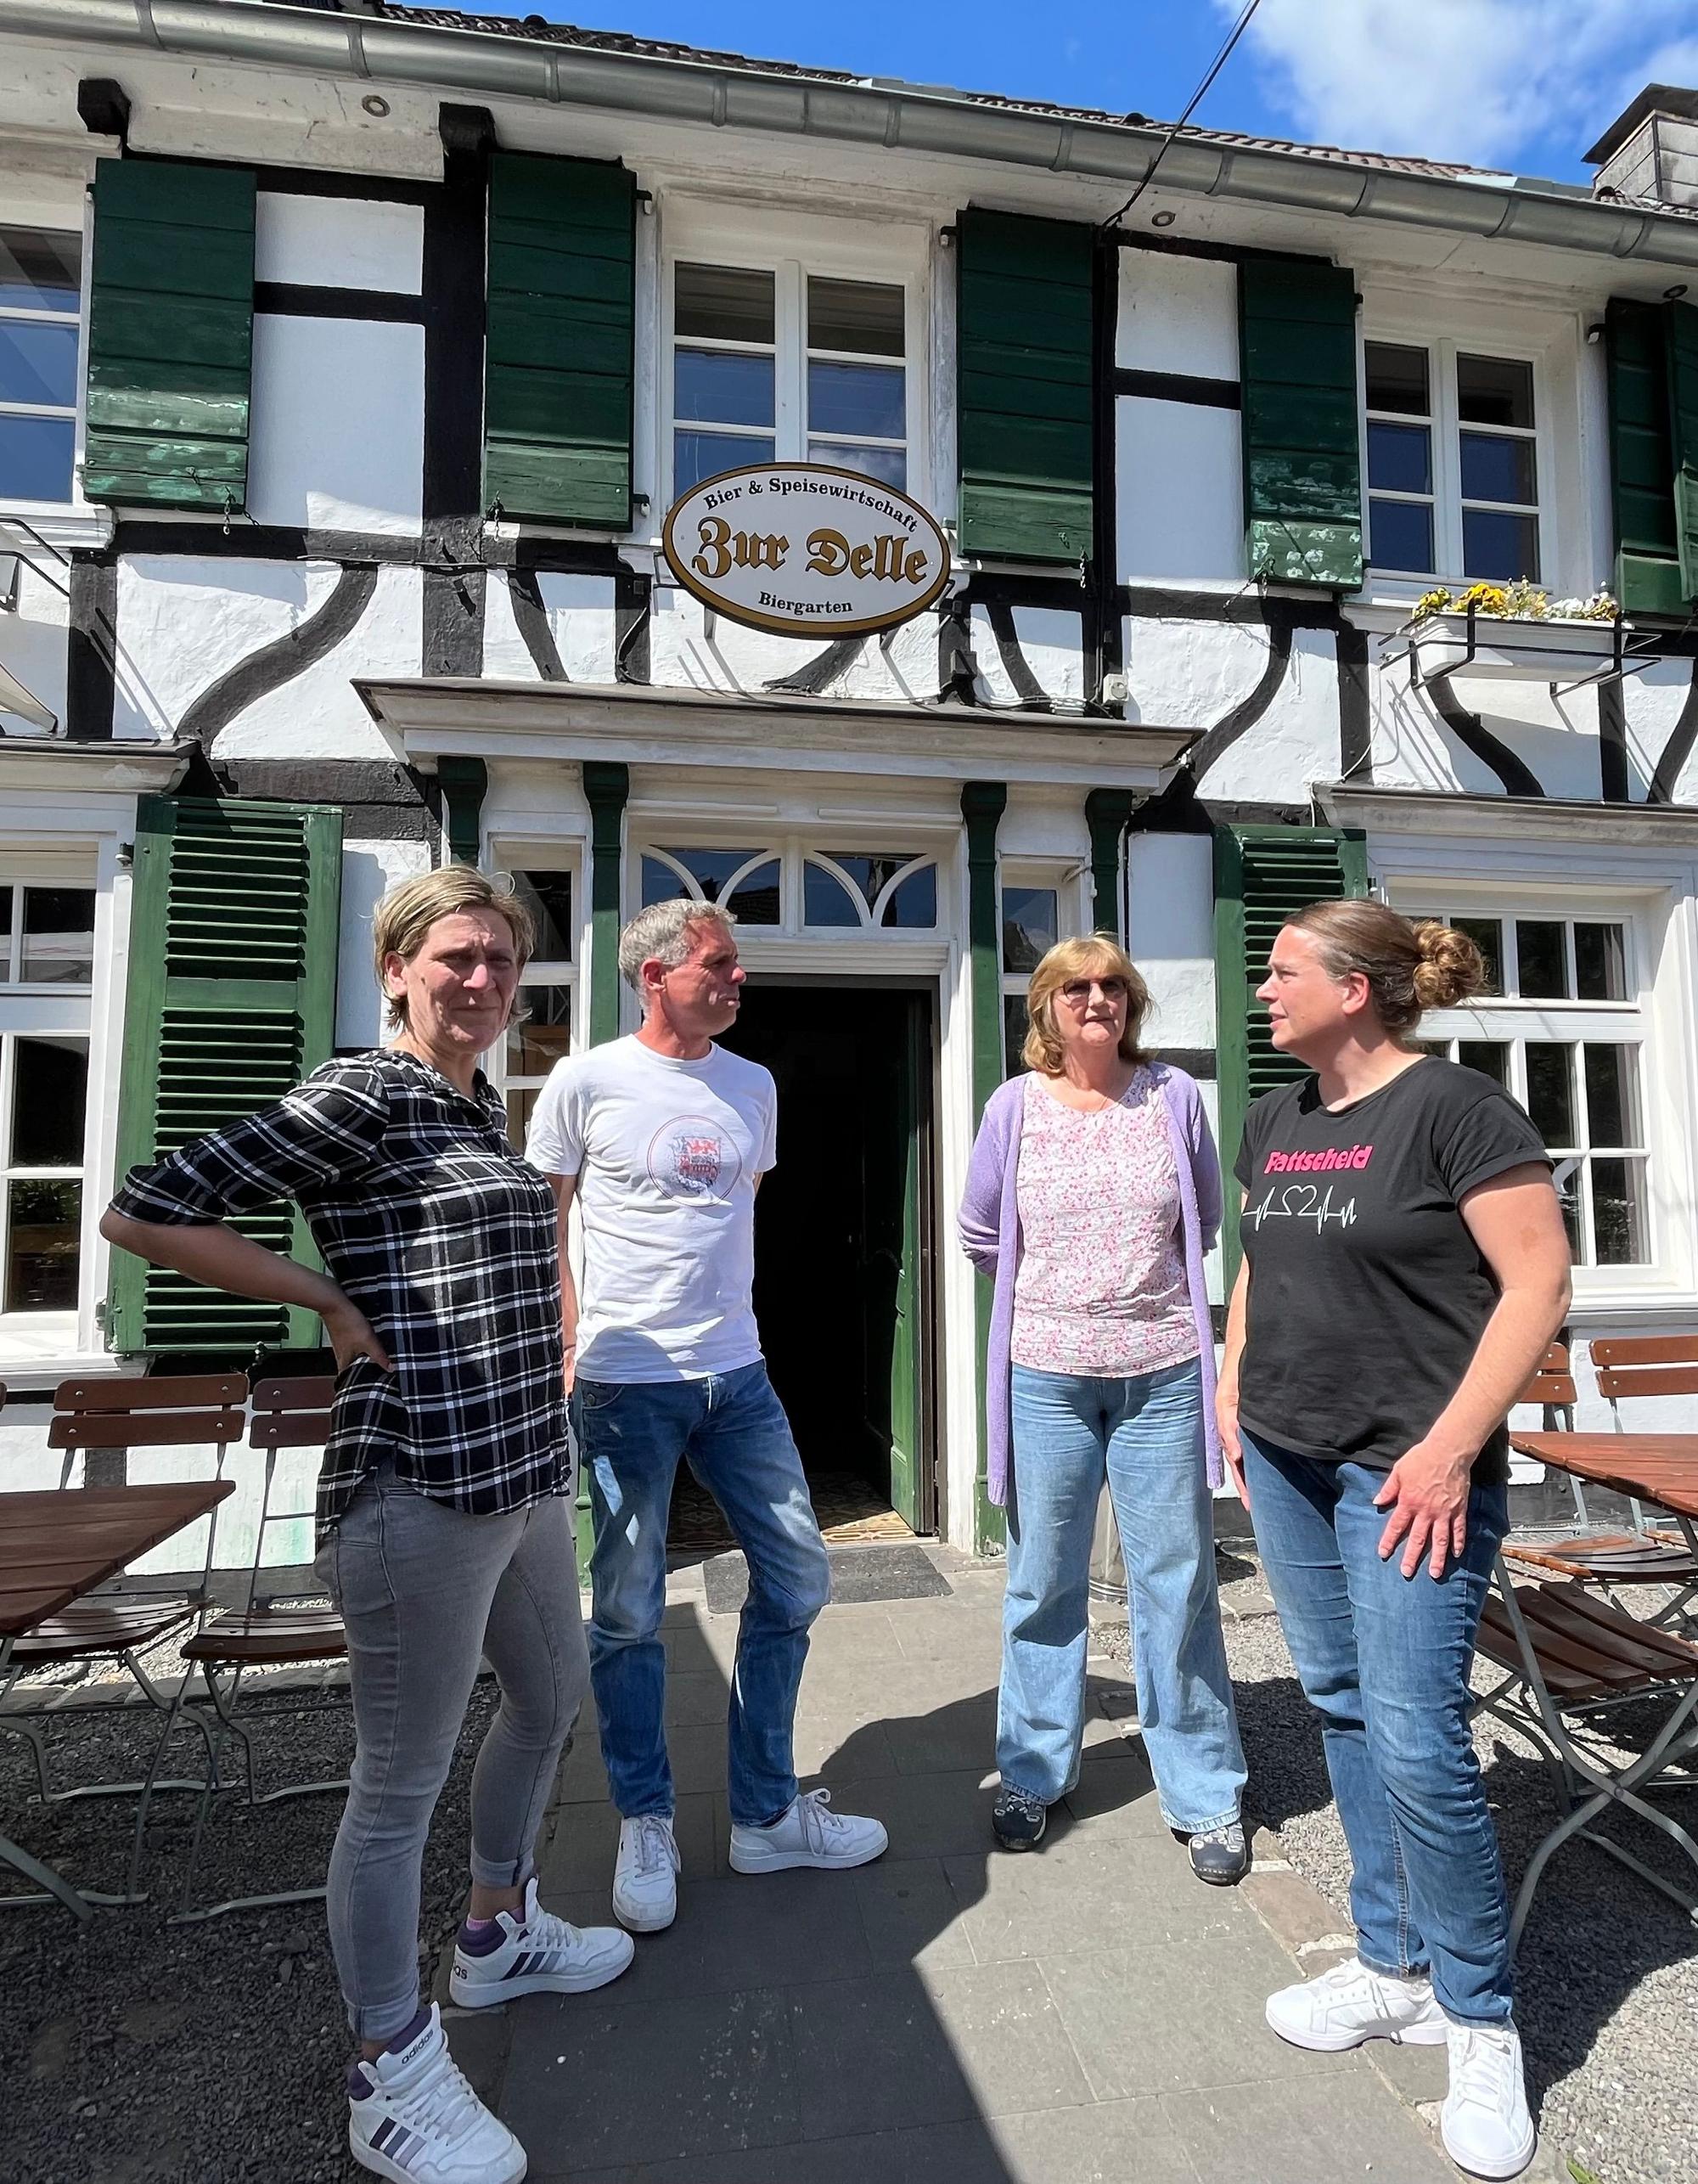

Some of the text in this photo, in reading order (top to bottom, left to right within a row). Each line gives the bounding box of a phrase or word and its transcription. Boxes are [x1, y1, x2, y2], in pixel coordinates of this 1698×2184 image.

[704, 478, 918, 533] Bier & Speisewirtschaft
[692, 516, 927, 584] Zur Delle
[759, 591, 852, 616] Biergarten
[402, 2029, 434, 2064] adidas
